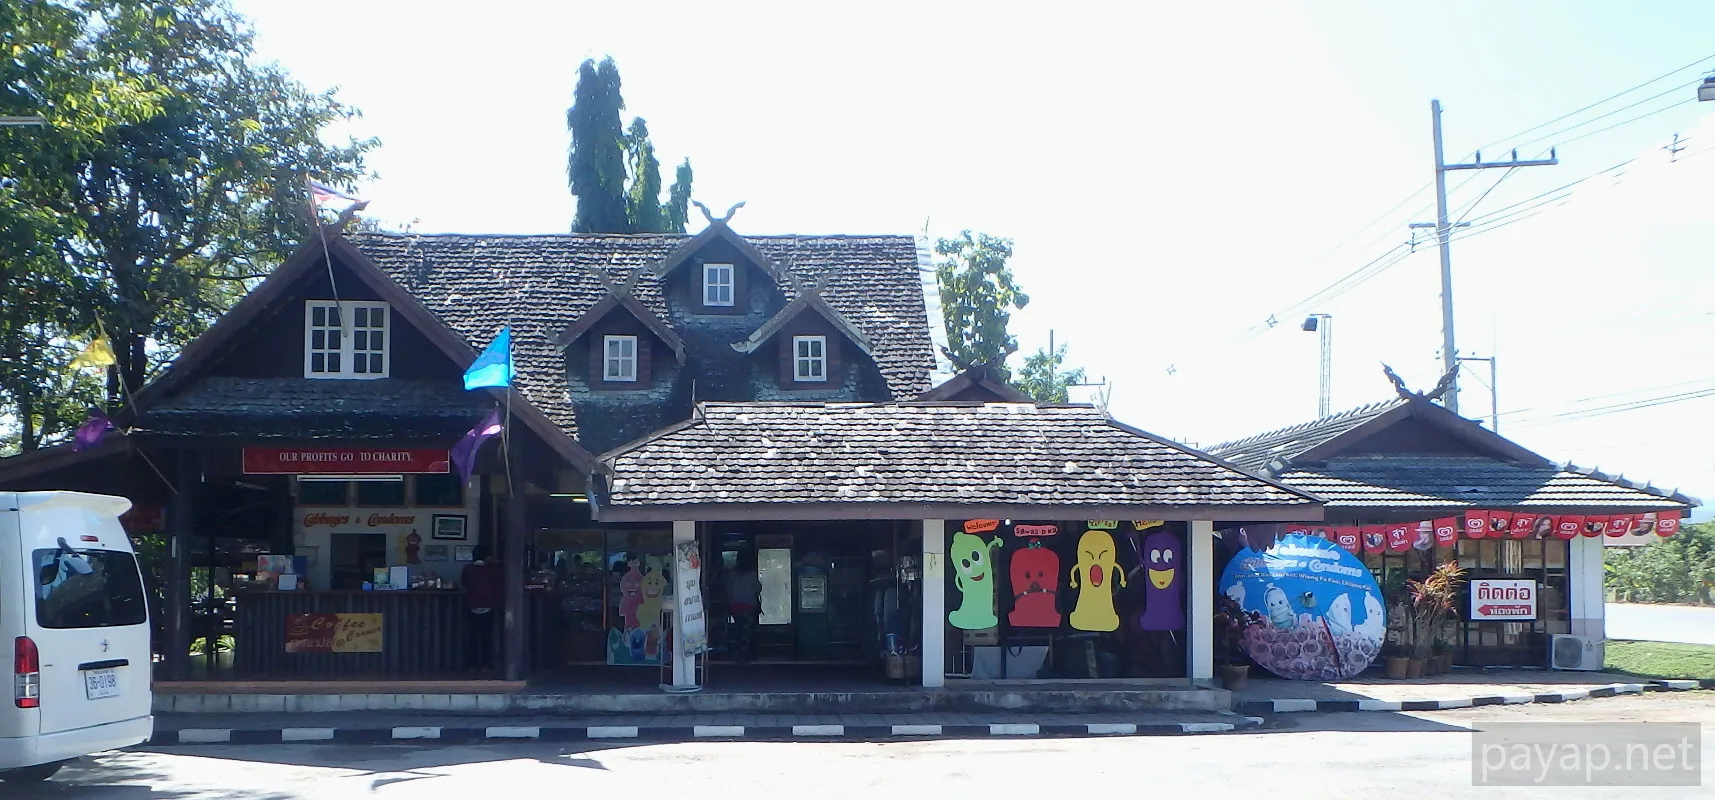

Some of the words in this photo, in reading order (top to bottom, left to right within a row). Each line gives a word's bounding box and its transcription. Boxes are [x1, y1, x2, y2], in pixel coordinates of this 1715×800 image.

[279, 452, 298, 461] OUR
[301, 452, 338, 461] PROFITS
[340, 452, 354, 461] GO
[360, 452, 371, 461] TO
[1478, 582, 1531, 600] ติดต่อ
[1490, 605, 1528, 615] ห้องพัก
